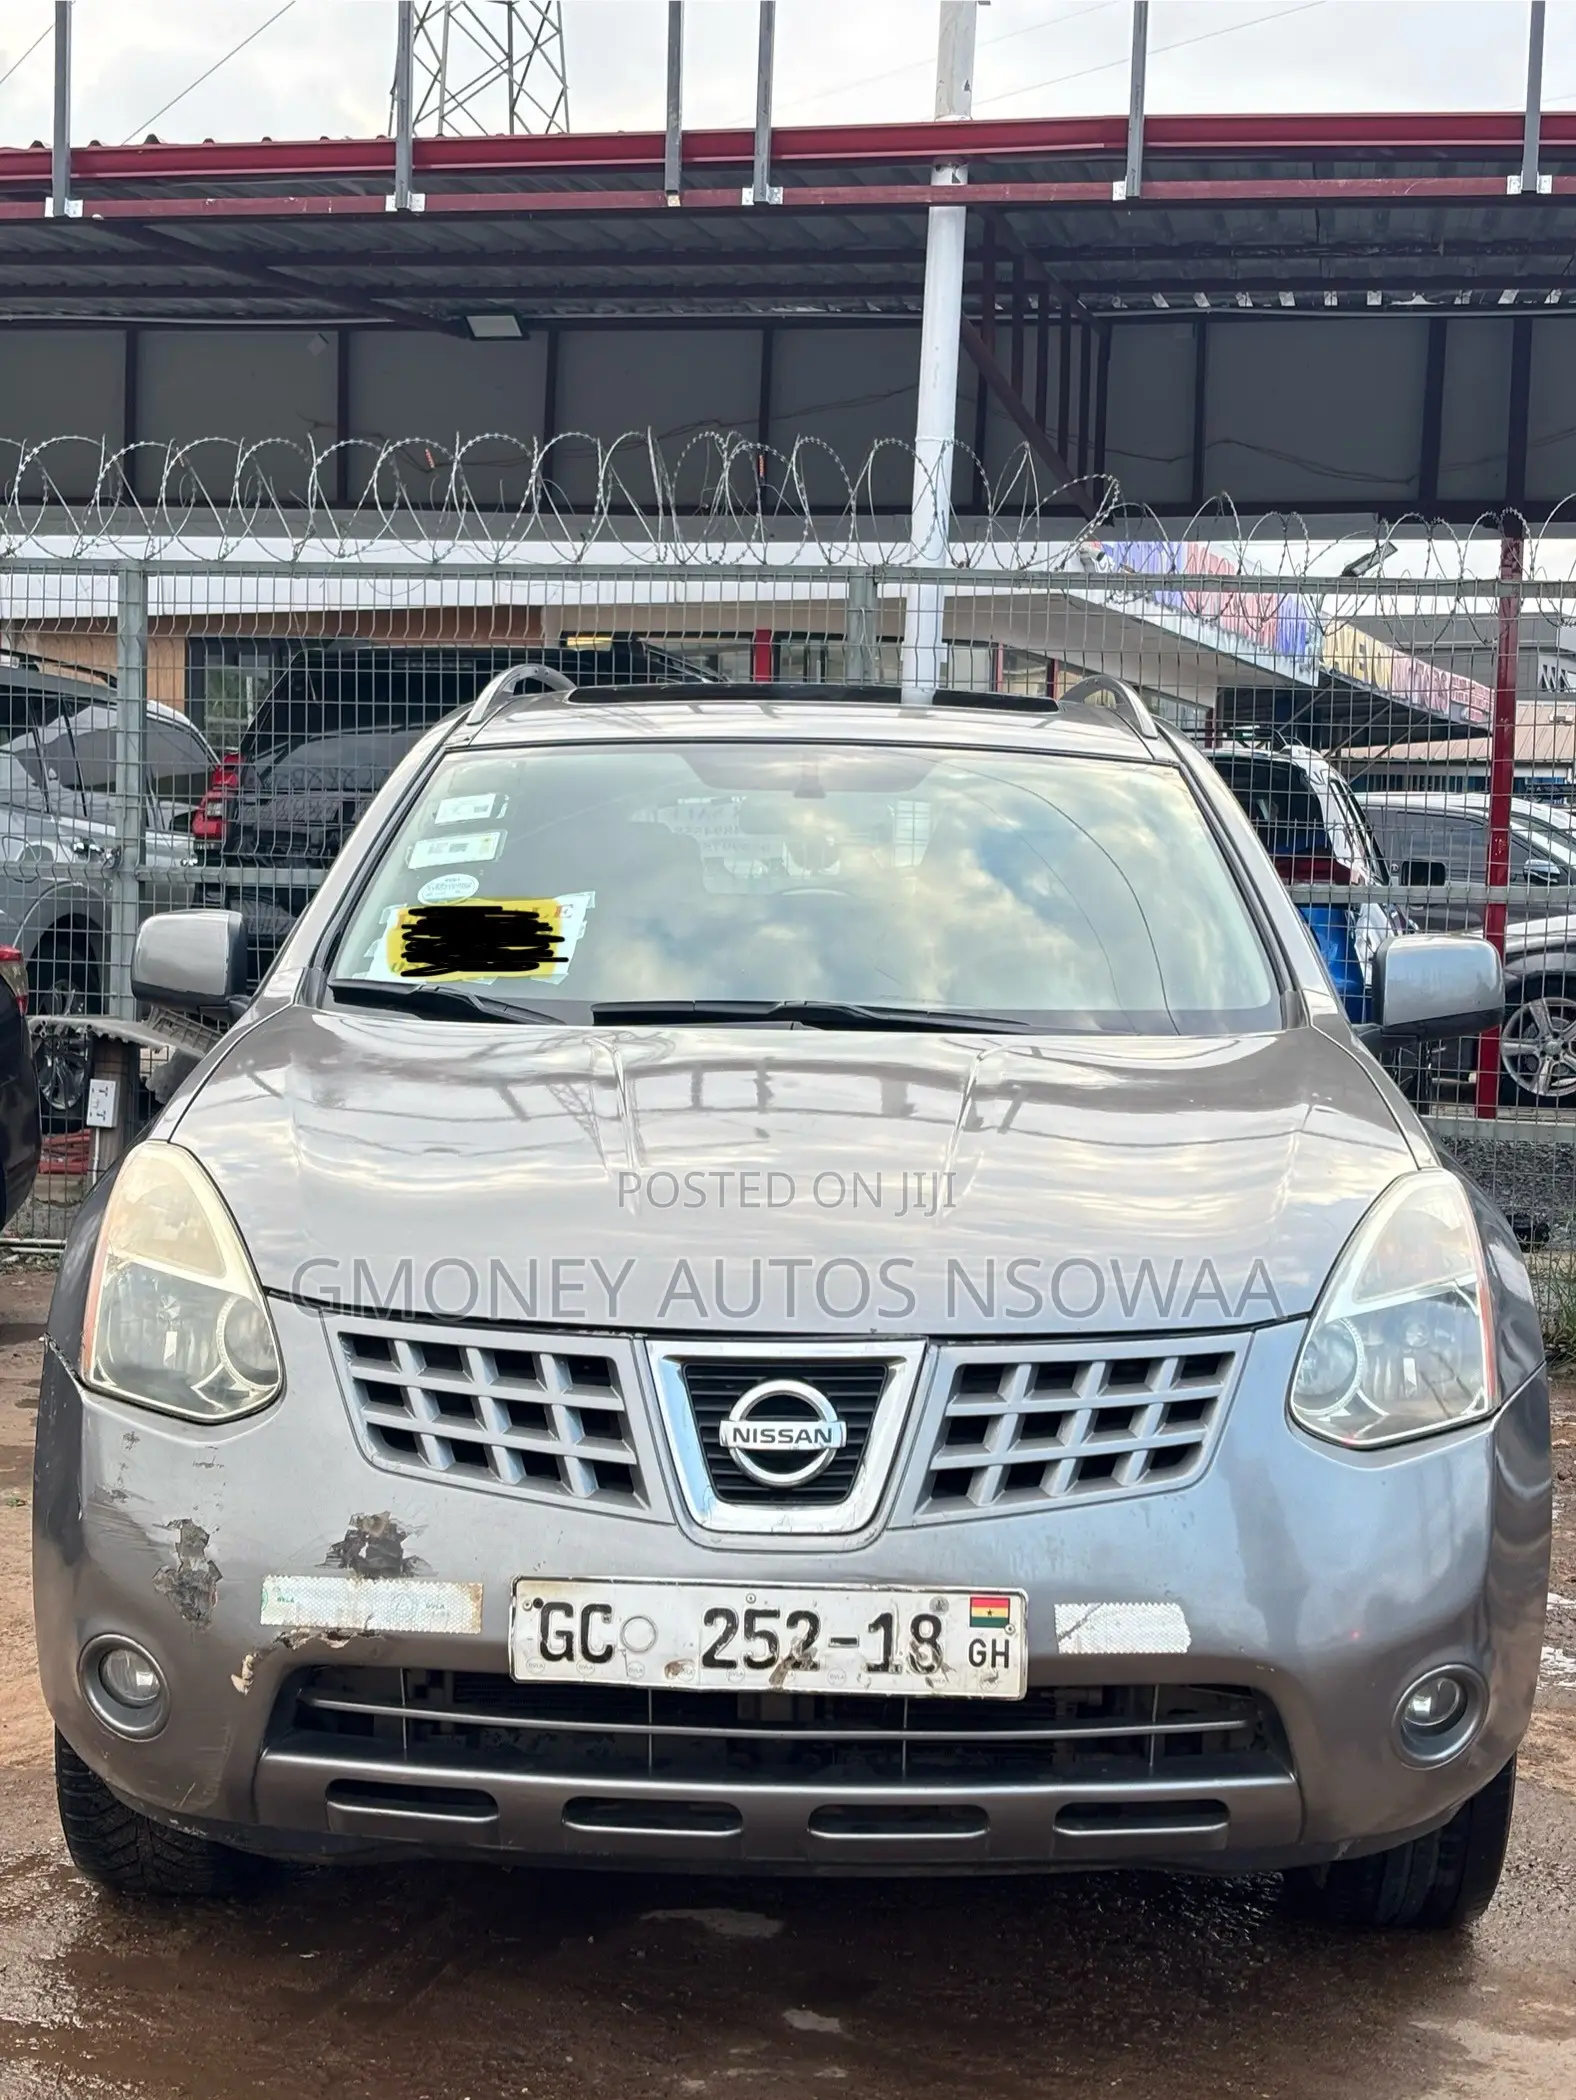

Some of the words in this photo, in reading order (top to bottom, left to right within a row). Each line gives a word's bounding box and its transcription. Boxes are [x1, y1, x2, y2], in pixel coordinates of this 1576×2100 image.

[733, 1427, 833, 1444] NISSAN
[538, 1600, 614, 1664] GC
[701, 1607, 944, 1675] 252-18
[967, 1638, 1010, 1669] GH
